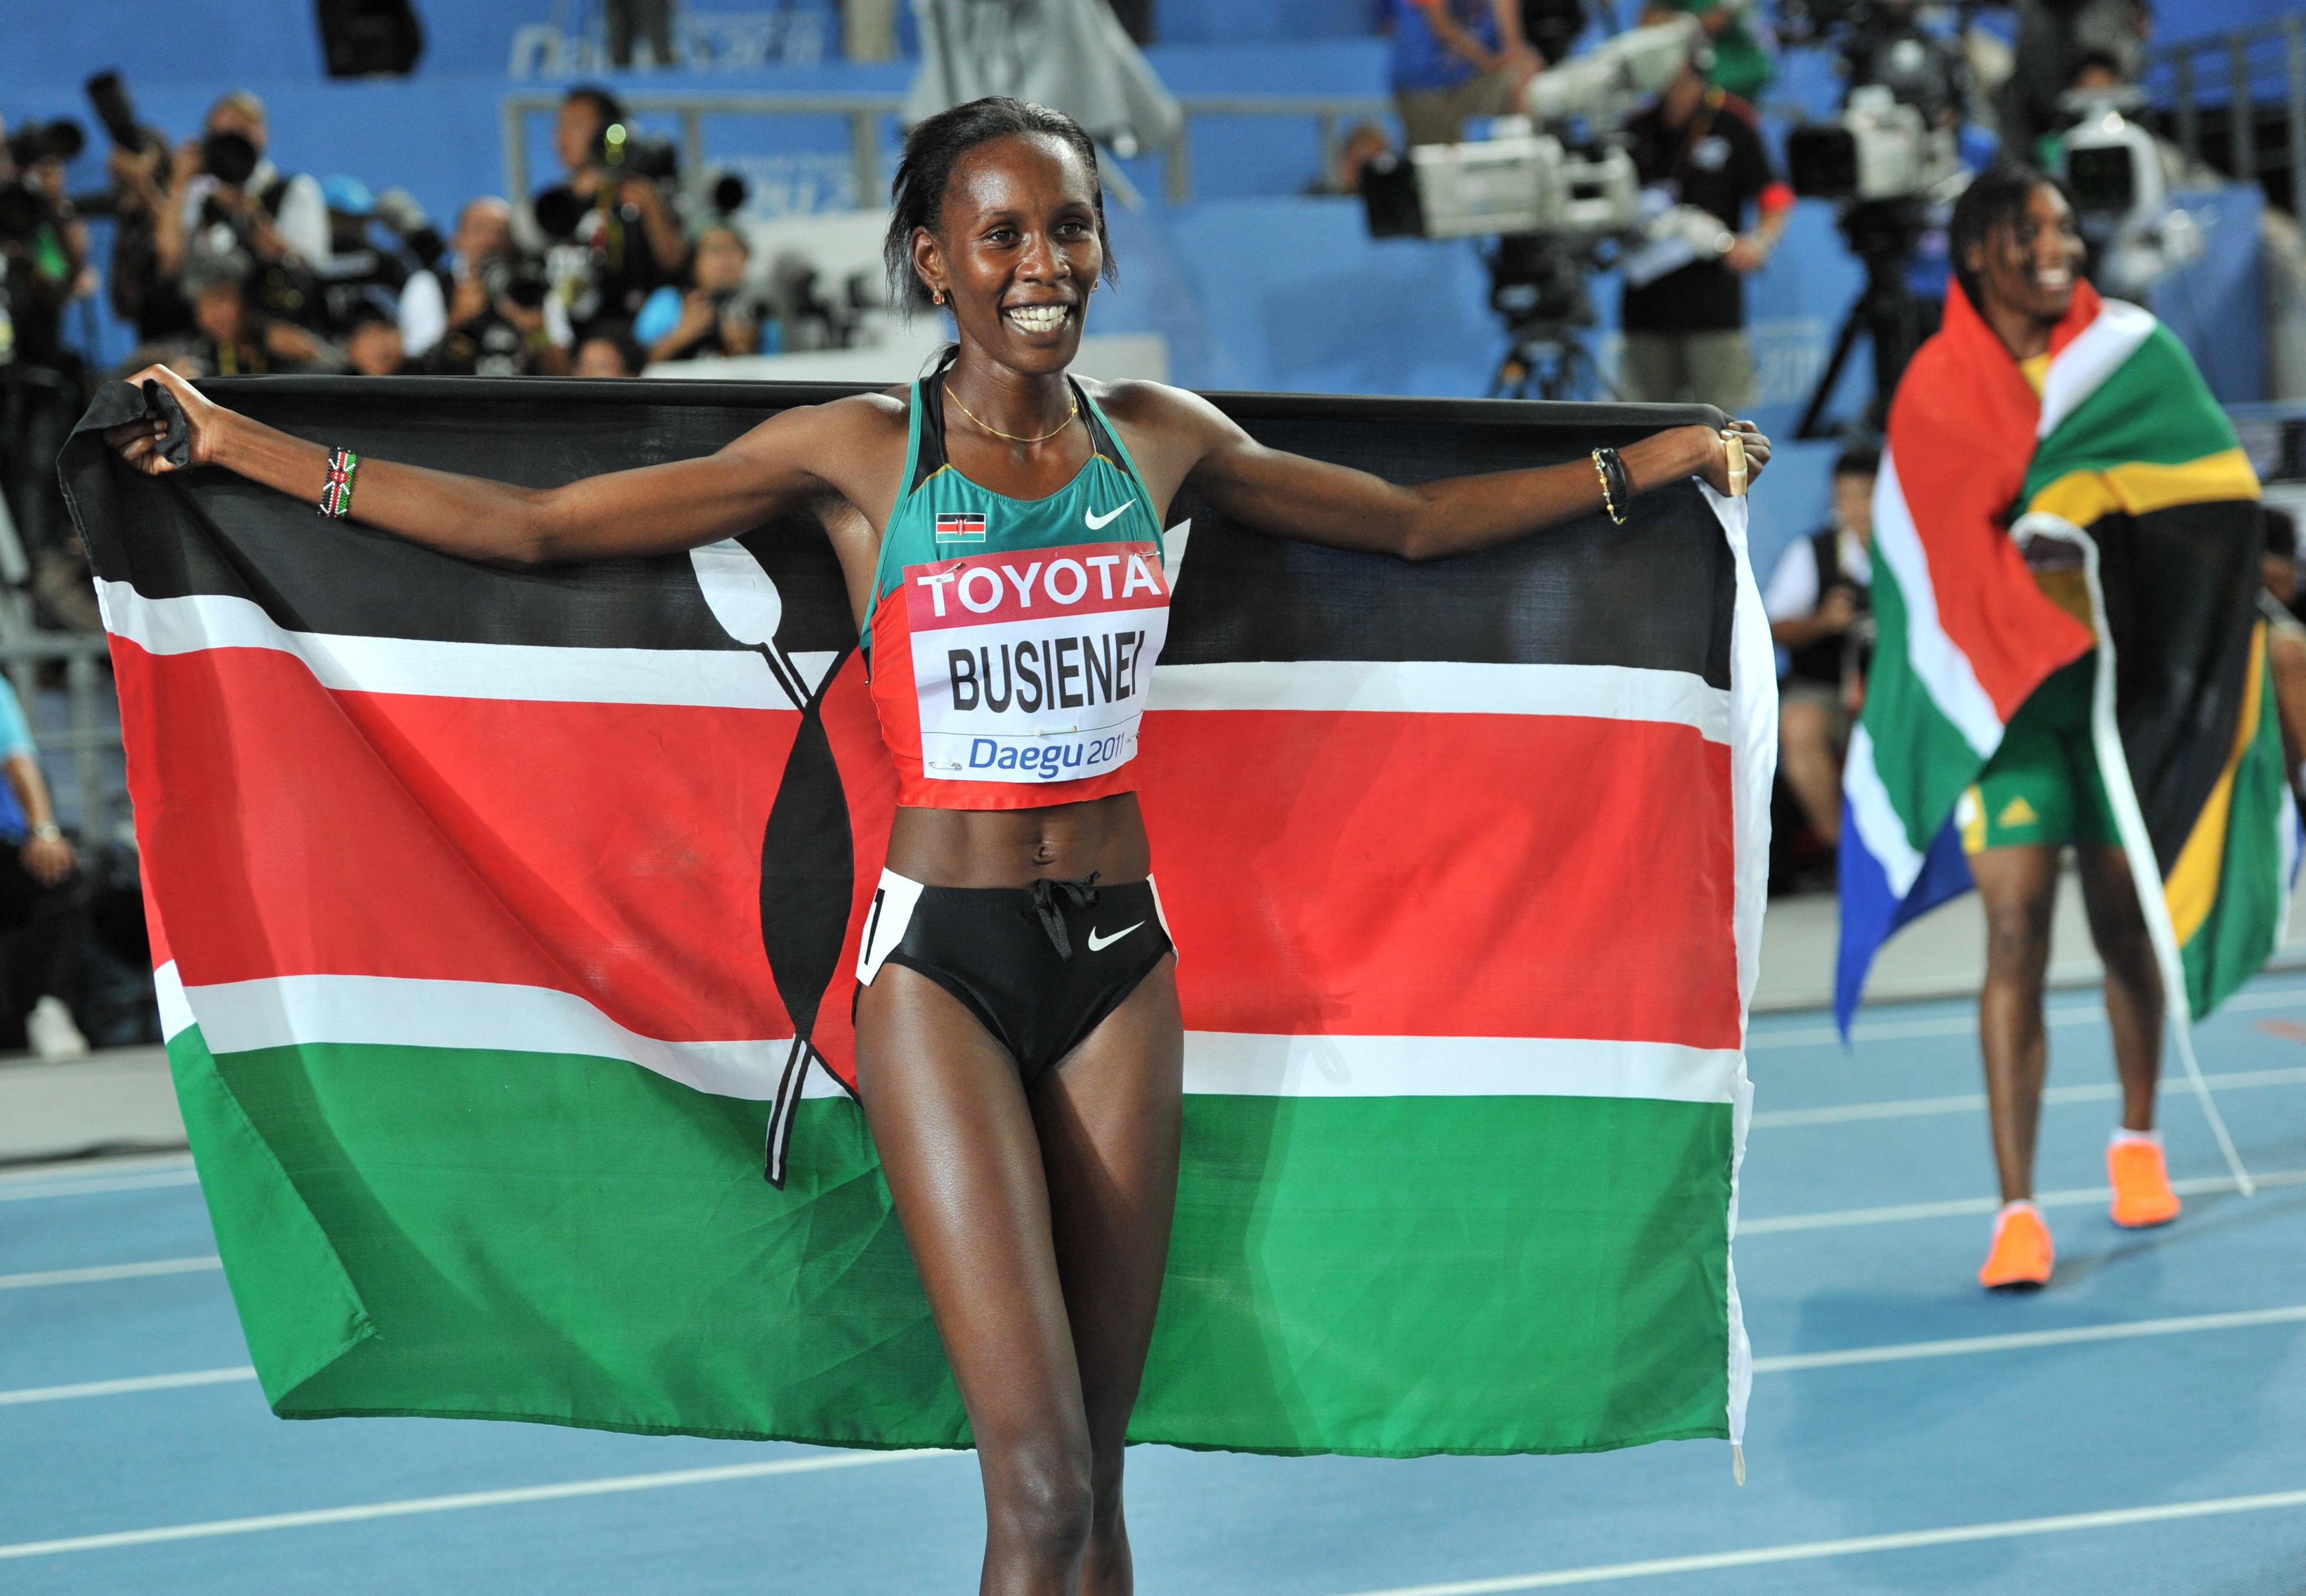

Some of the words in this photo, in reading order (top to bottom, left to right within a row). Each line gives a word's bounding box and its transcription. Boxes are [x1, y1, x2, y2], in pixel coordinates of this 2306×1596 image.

[917, 554, 1162, 617] TOYOTA
[948, 630, 1146, 714] BUSIENEI
[969, 738, 1084, 779] Daegu
[1087, 731, 1125, 765] 2011
